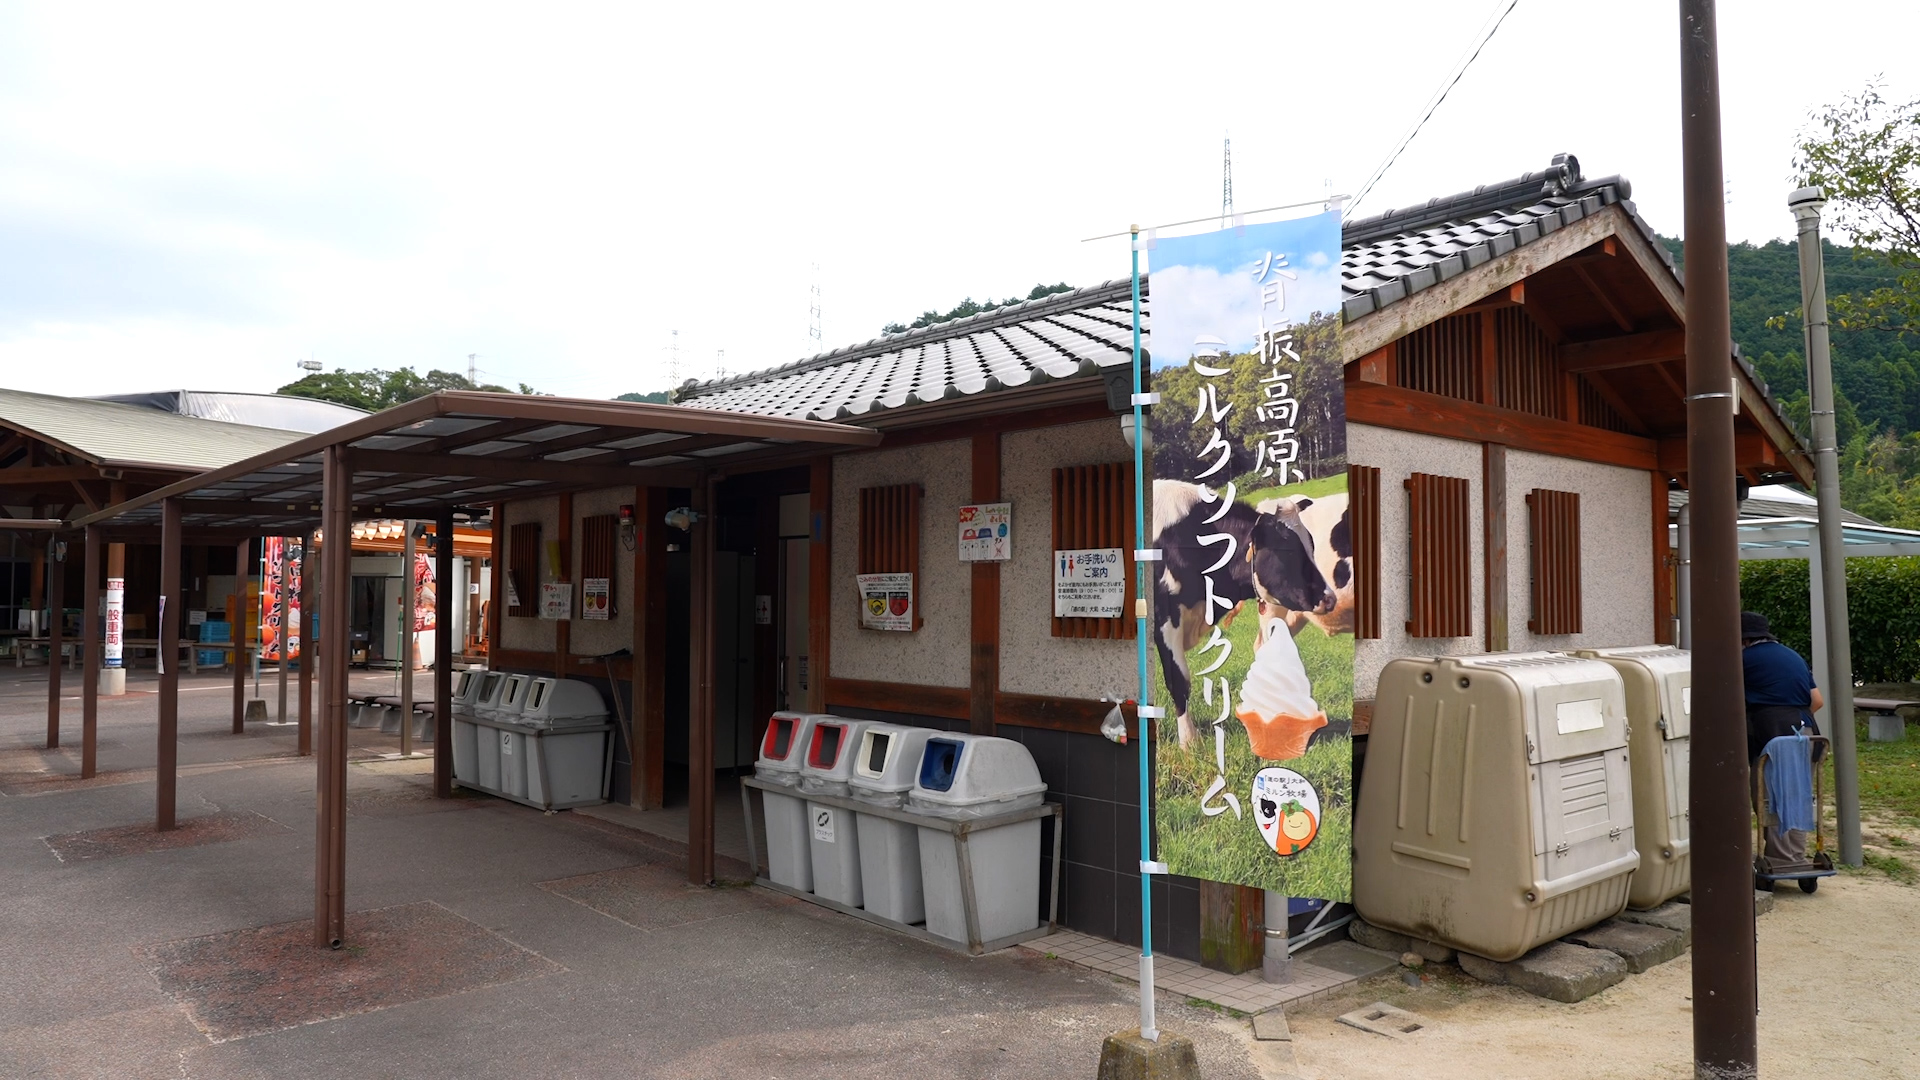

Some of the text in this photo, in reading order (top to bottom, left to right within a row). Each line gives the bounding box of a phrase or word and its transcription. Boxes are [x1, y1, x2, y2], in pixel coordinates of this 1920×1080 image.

[1250, 250, 1305, 486] 脊振高原
[1076, 553, 1117, 565] お手洗いの
[1083, 567, 1109, 579] ご案内
[1192, 334, 1241, 821] ミルクソフトクリーム
[106, 600, 120, 646] 一般車両
[1265, 786, 1308, 798] ミルン牧場
